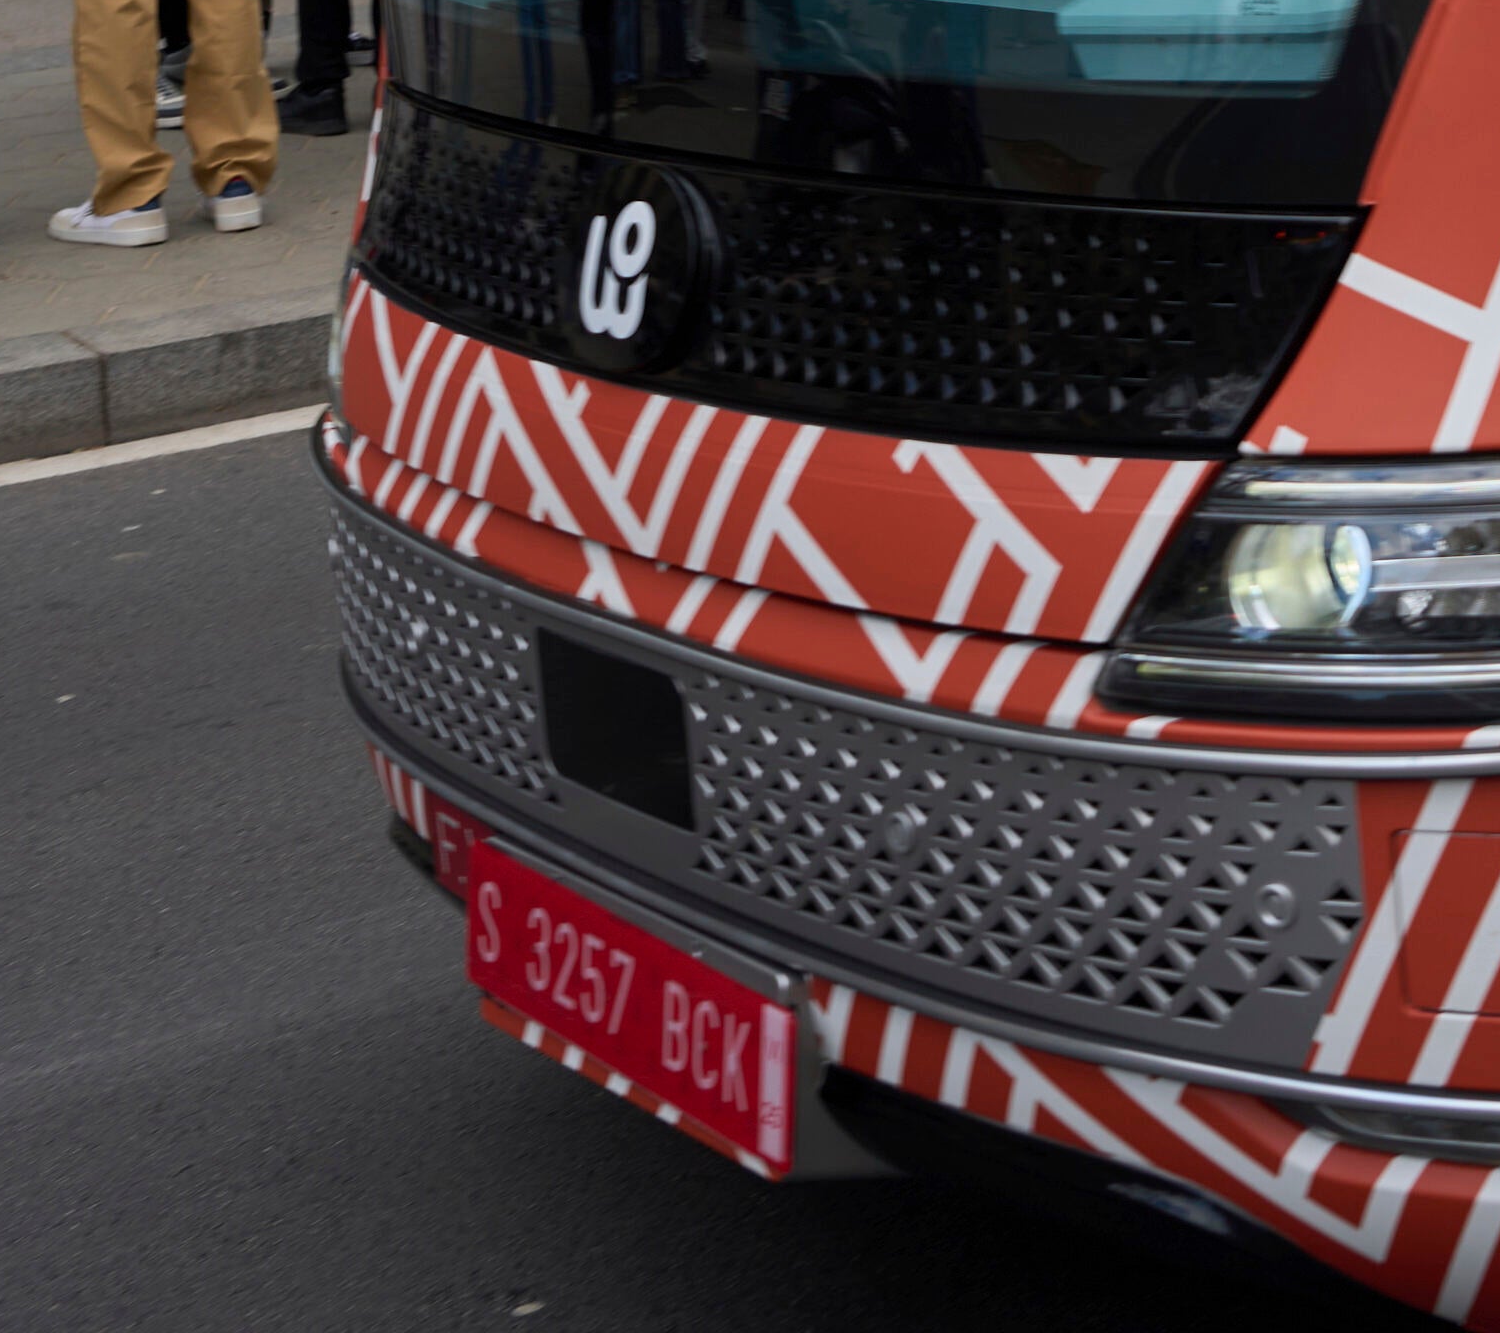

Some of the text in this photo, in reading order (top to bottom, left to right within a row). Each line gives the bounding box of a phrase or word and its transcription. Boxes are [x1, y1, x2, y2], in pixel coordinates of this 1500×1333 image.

[477, 880, 752, 1112] S 3257 BCK
